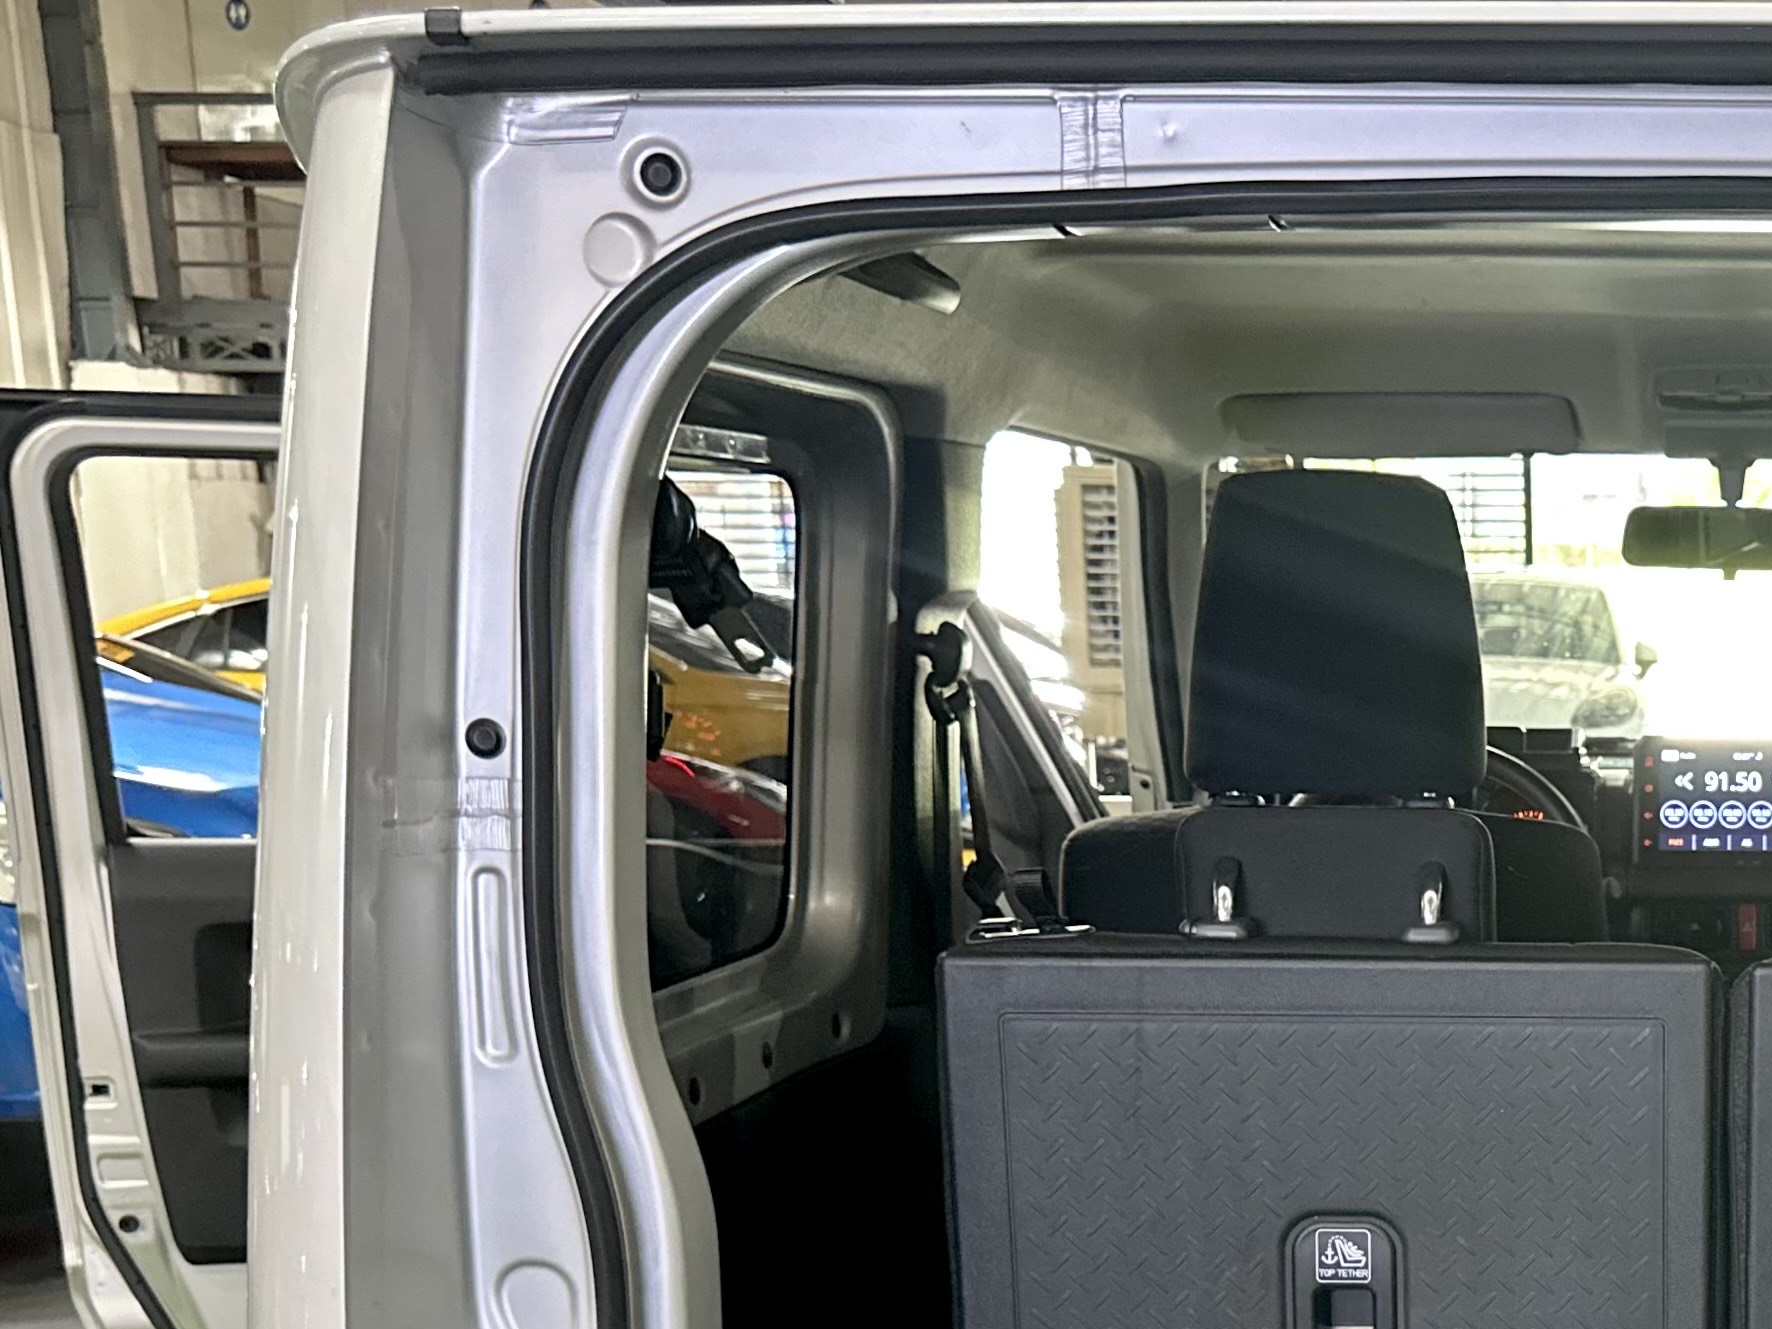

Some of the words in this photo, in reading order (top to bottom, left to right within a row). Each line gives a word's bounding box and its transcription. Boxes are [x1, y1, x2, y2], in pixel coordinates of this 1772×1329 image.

[1704, 770, 1763, 792] 91.50
[1319, 1268, 1336, 1278] TOP
[1336, 1268, 1369, 1278] TETHER
